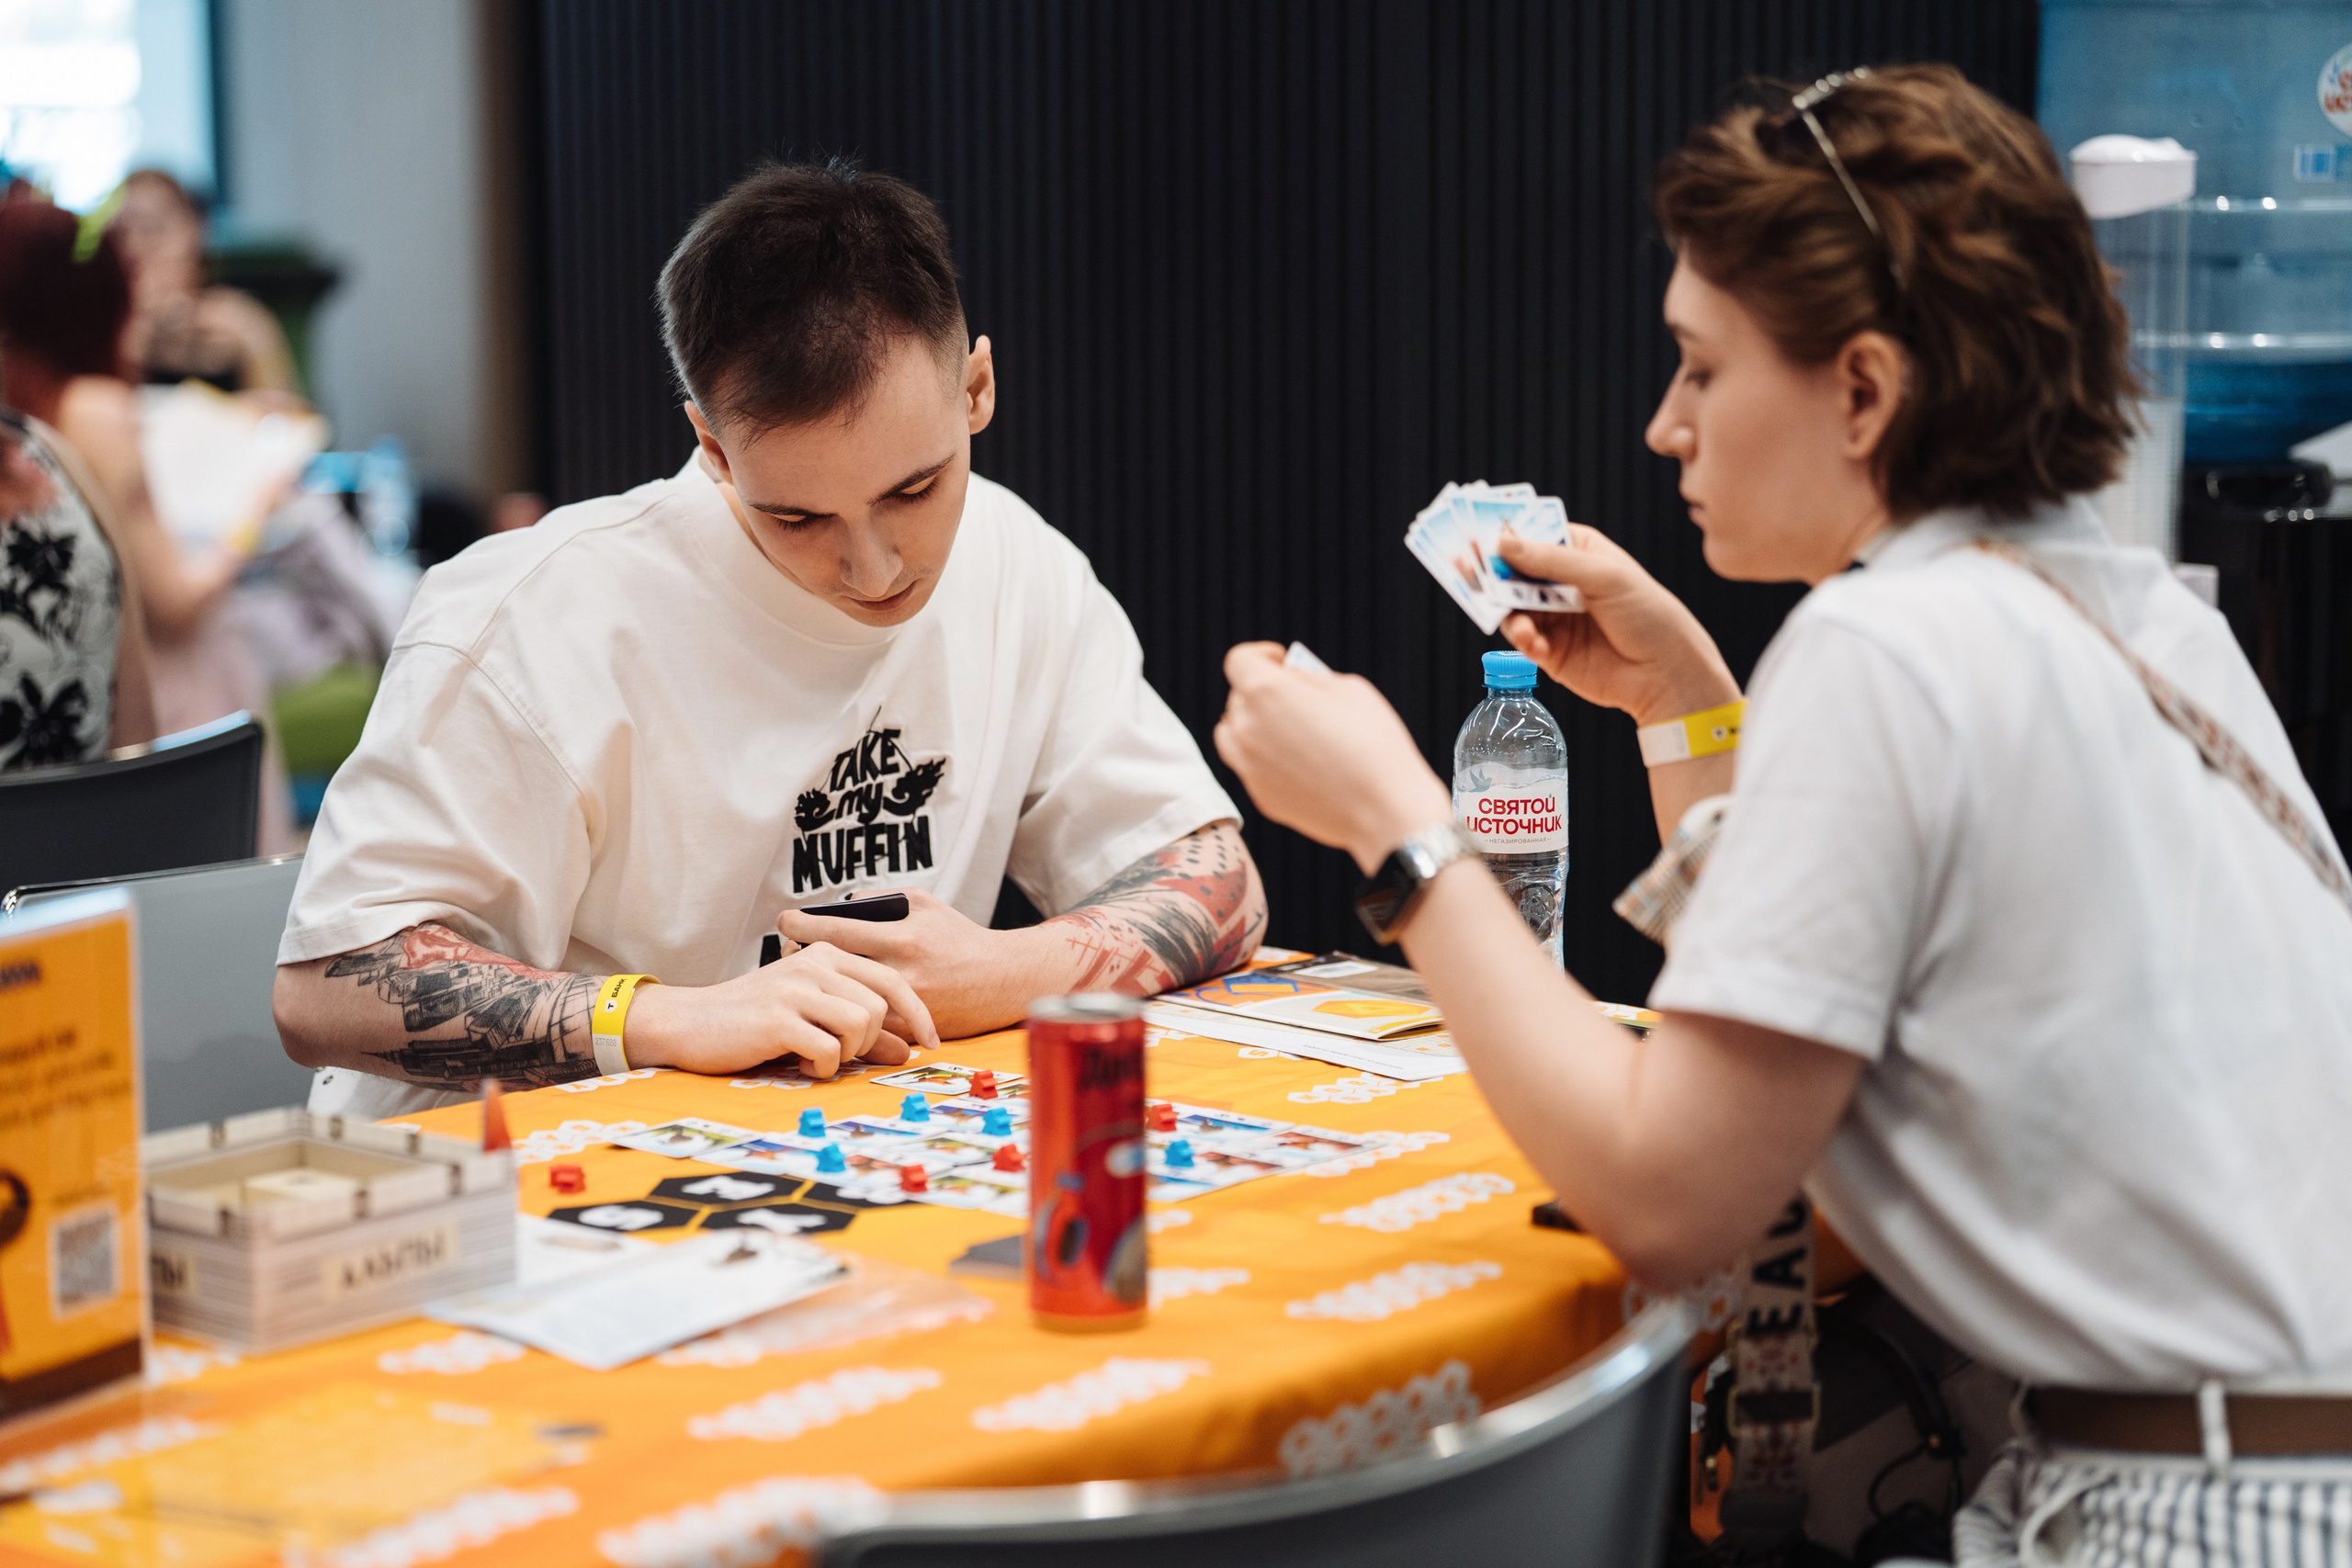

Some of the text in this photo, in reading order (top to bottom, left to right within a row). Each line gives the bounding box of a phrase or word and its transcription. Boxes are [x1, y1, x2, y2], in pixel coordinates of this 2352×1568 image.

[830, 728, 901, 793] TAKE
[1466, 814, 1562, 835] ИСТОЧНИК
[1478, 794, 1555, 815] СВЯТОЙ
[793, 815, 933, 893] MUFFIN
